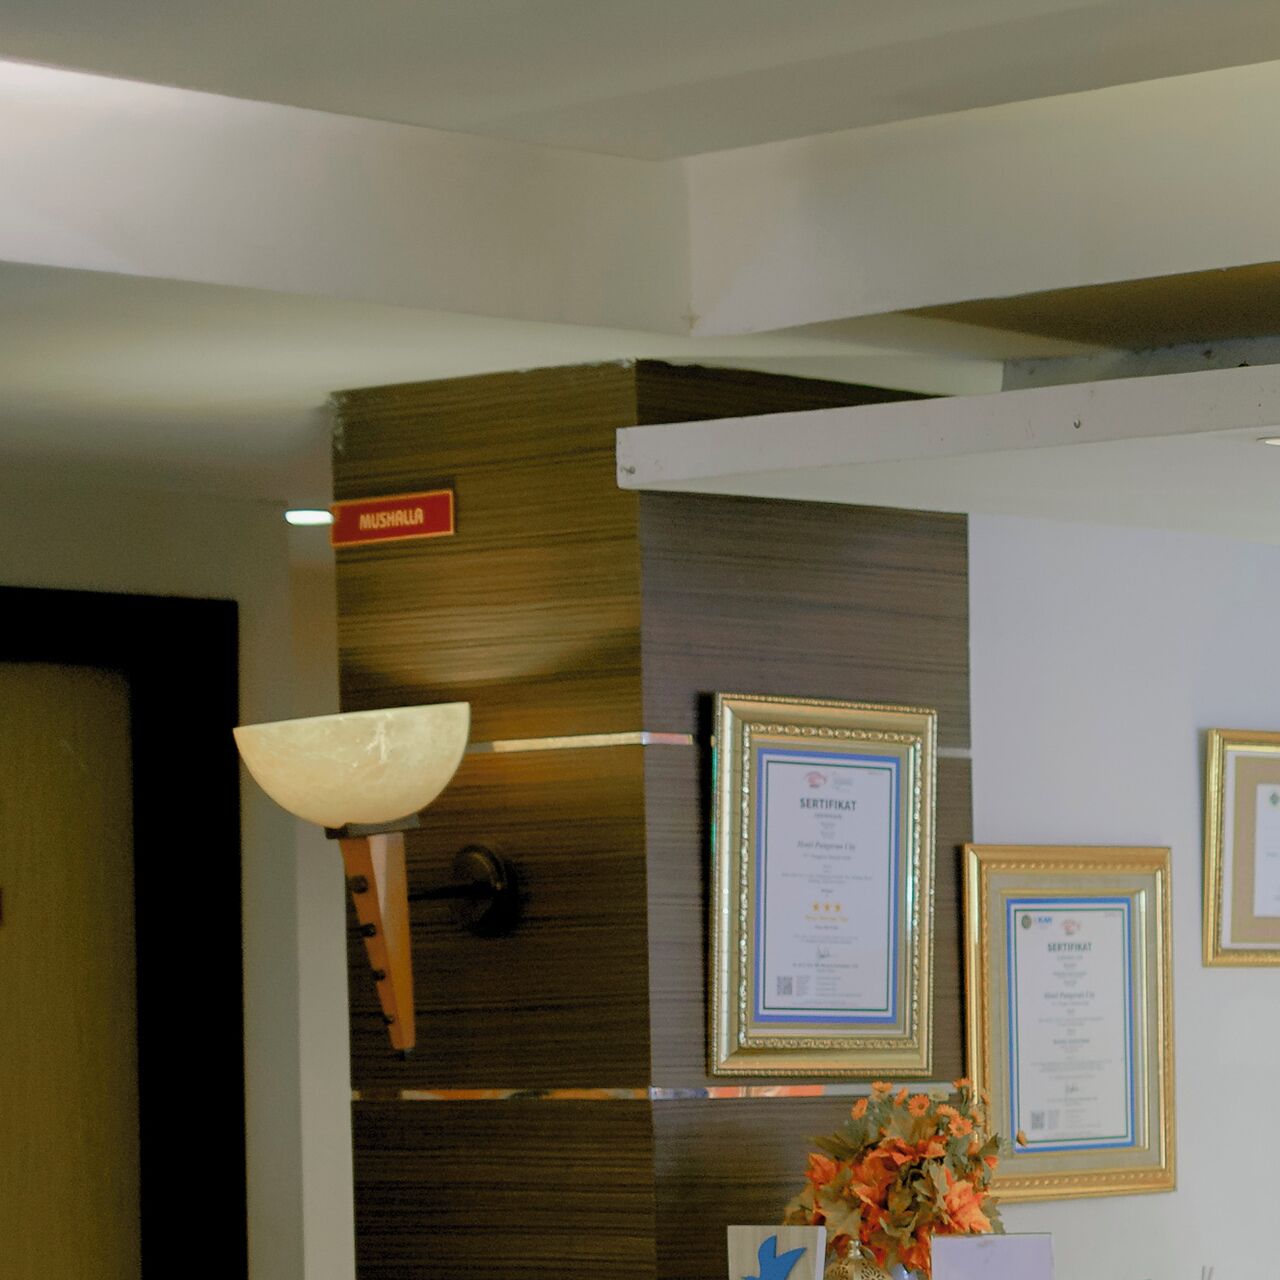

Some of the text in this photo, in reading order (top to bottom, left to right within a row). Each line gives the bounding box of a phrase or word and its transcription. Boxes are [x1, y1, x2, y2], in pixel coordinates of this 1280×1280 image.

[359, 507, 424, 531] MUSHALLA
[800, 797, 856, 811] SERTIFIKAT
[1047, 942, 1092, 953] SERTIFIKAT
